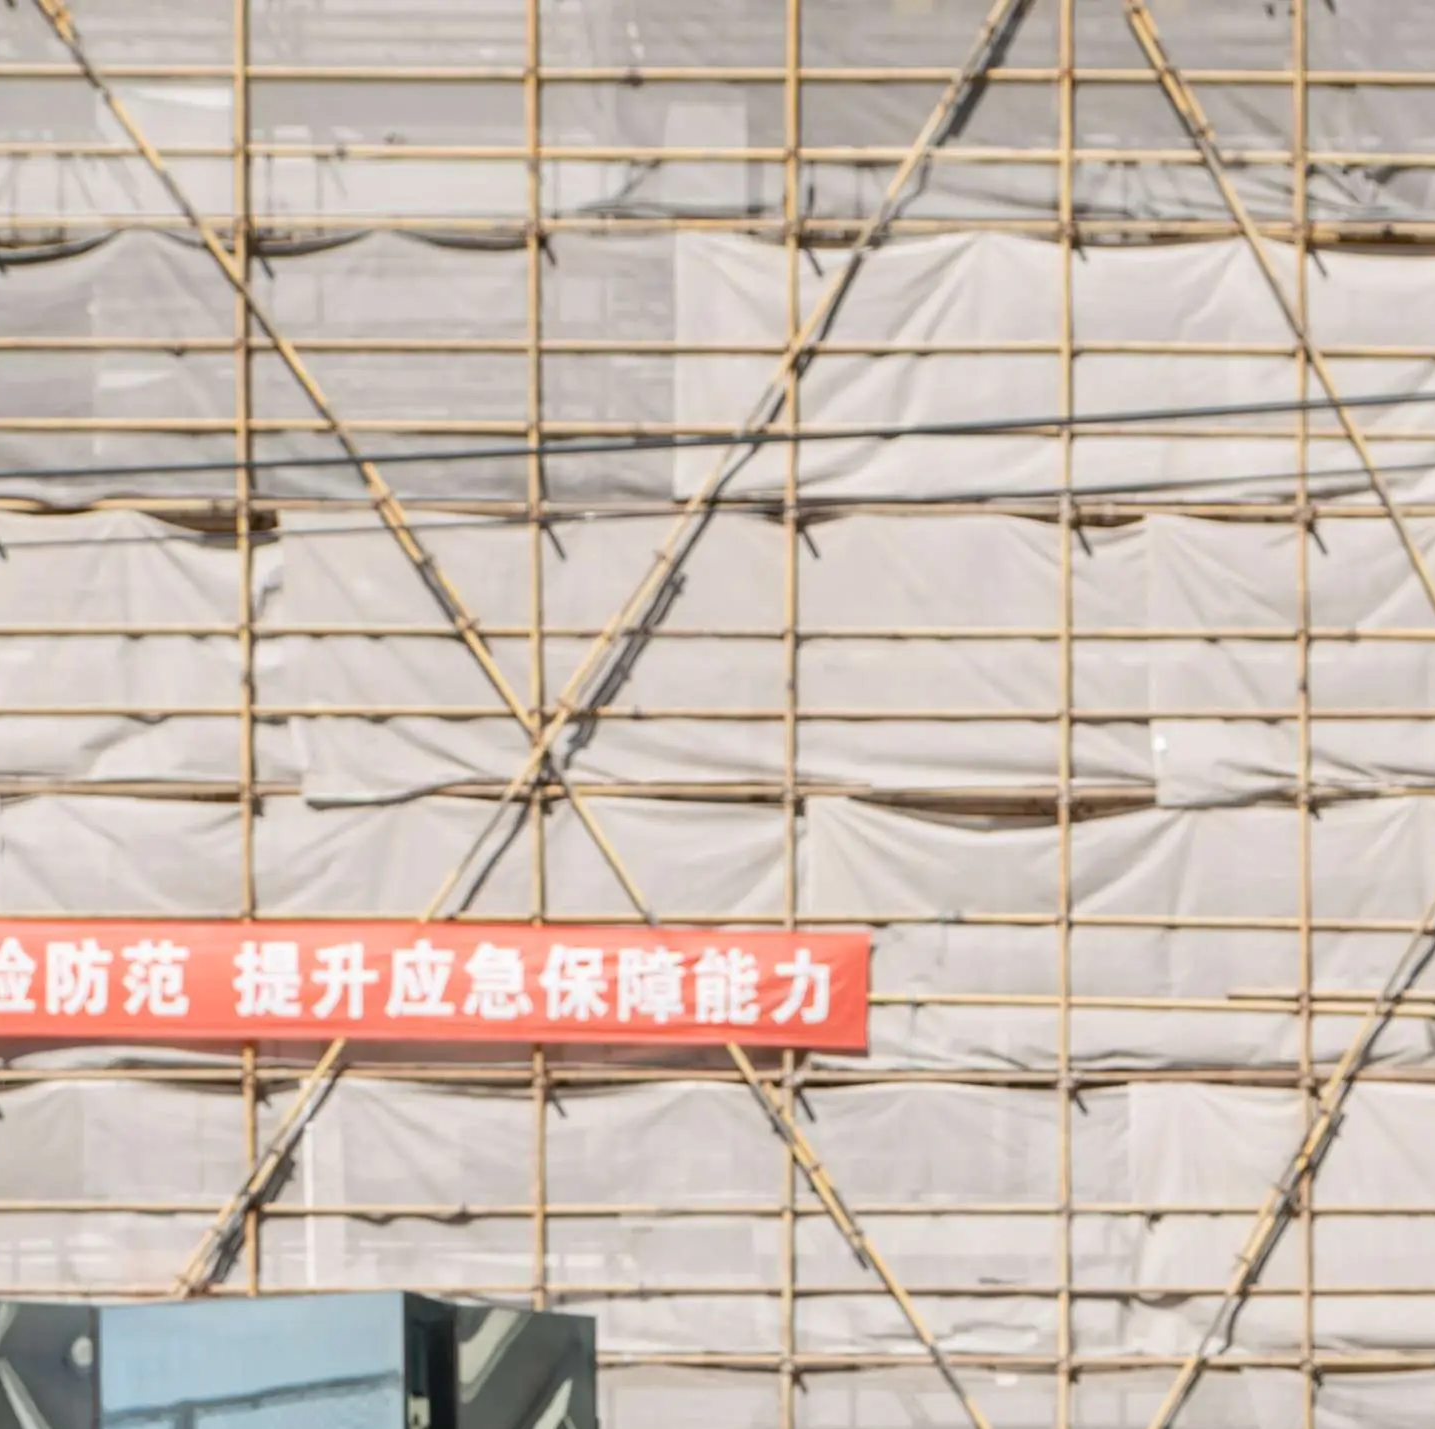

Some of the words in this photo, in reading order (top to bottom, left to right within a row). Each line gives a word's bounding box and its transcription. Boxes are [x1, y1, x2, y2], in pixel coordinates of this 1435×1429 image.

[231, 938, 832, 1025] 提升应急保障能力
